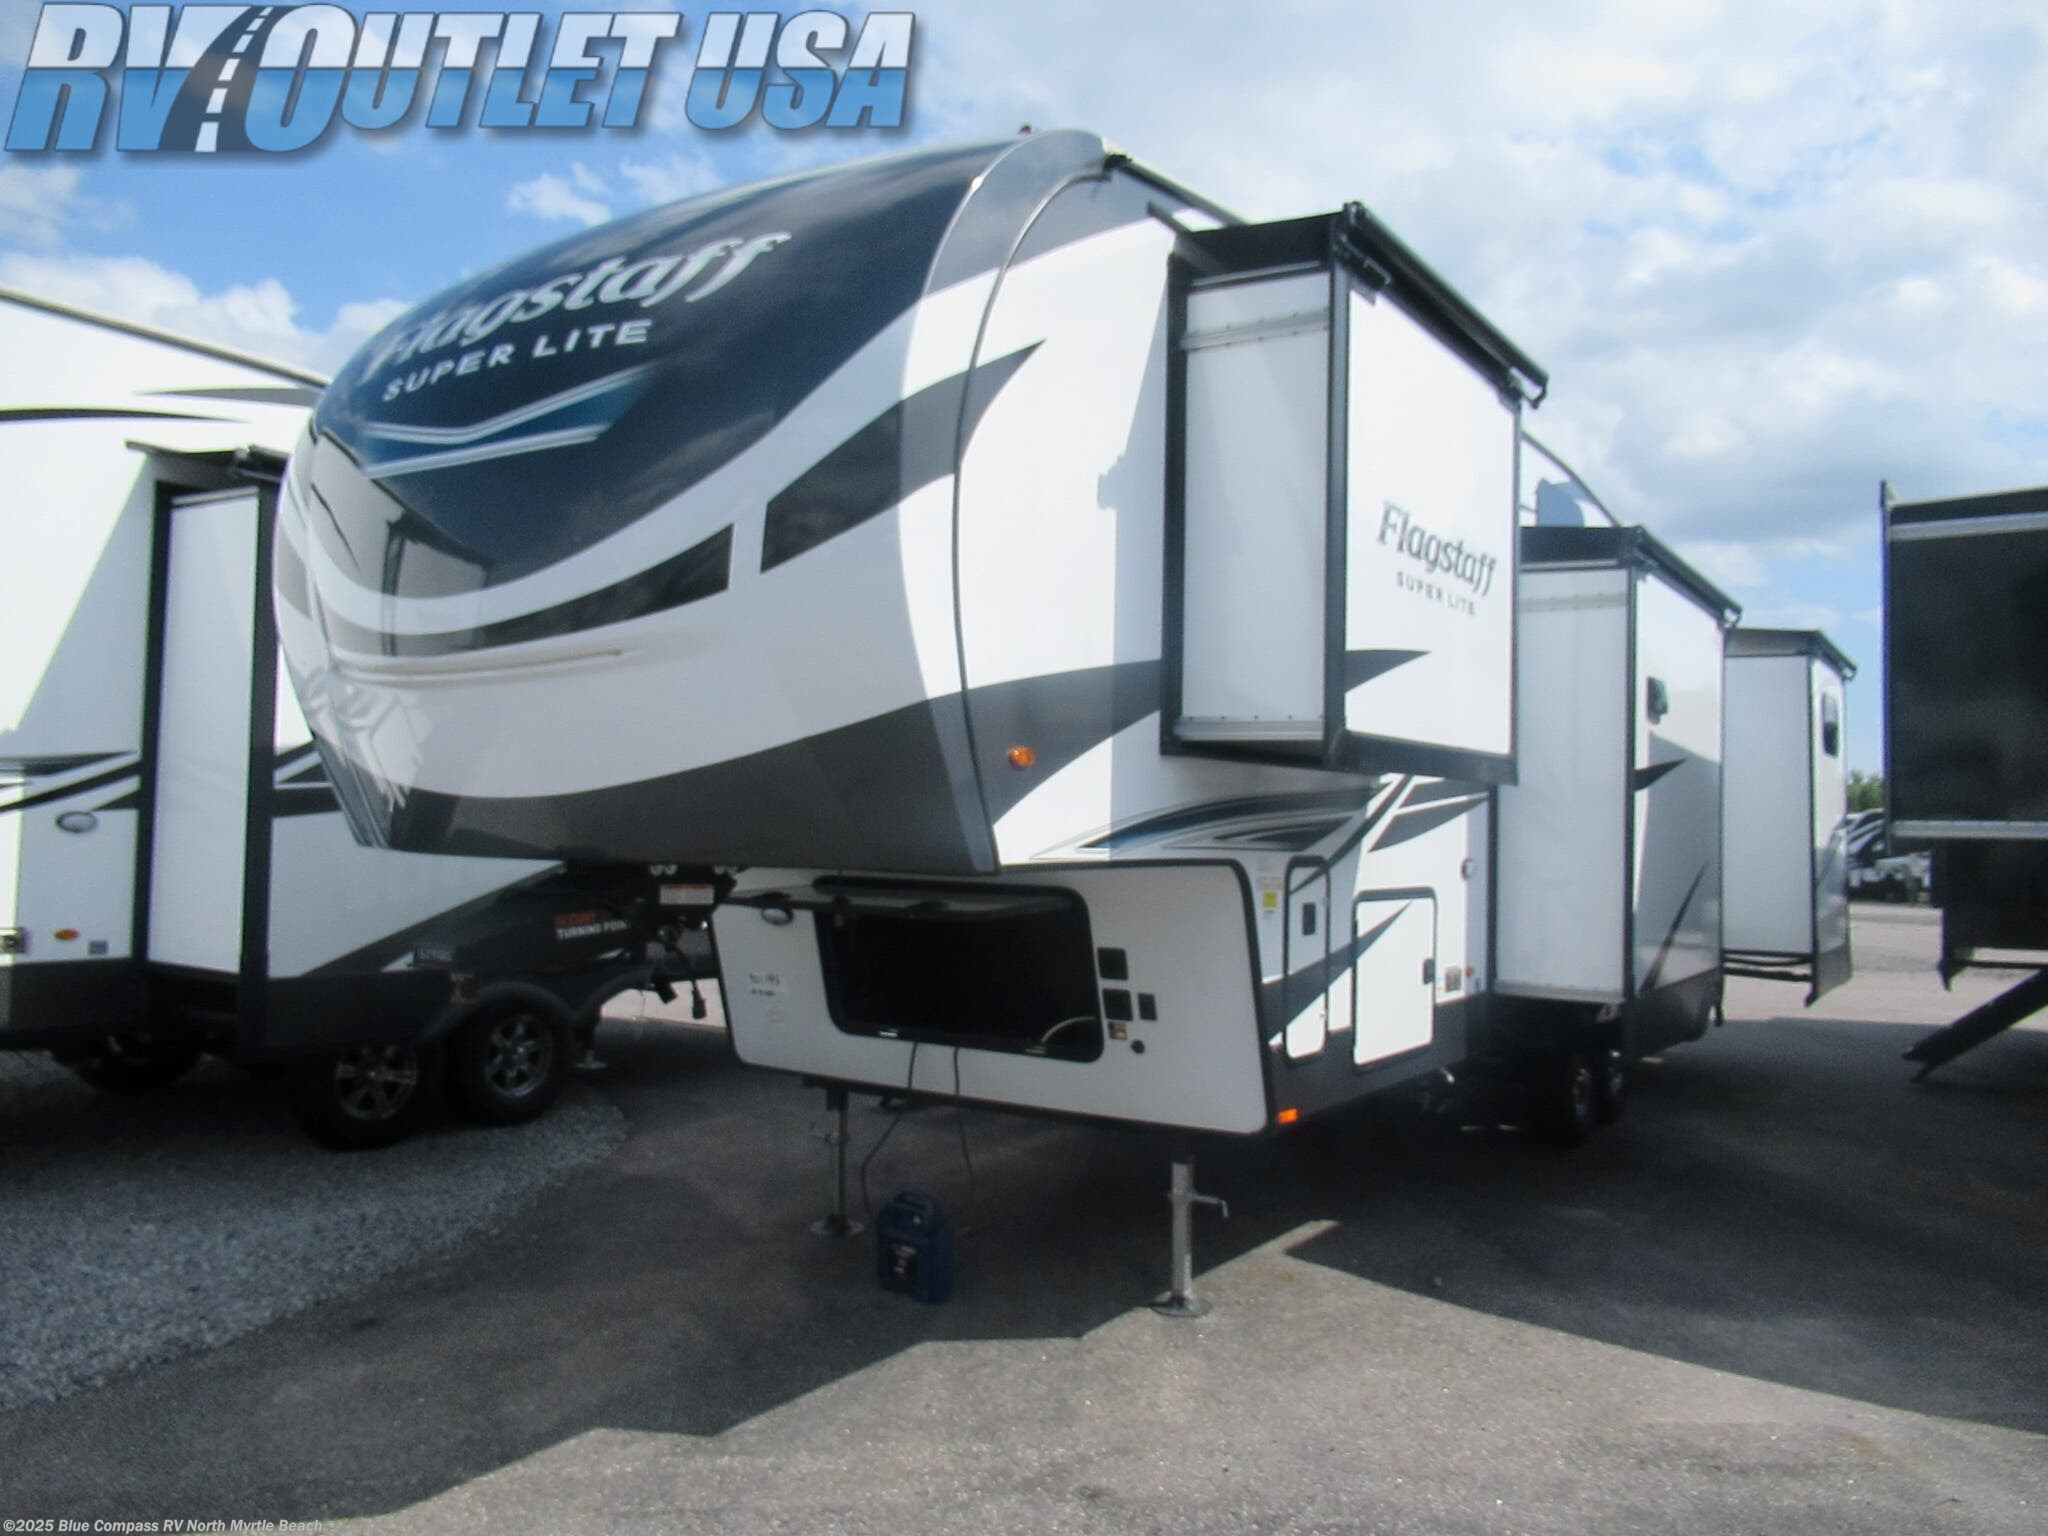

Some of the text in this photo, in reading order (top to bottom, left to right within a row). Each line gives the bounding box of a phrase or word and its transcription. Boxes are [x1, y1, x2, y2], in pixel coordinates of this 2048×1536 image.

[361, 231, 792, 384] Flagstaff
[383, 318, 653, 402] SUPER LITE
[1377, 500, 1497, 598] Flagstaff
[1396, 571, 1475, 616] SUPER LITE
